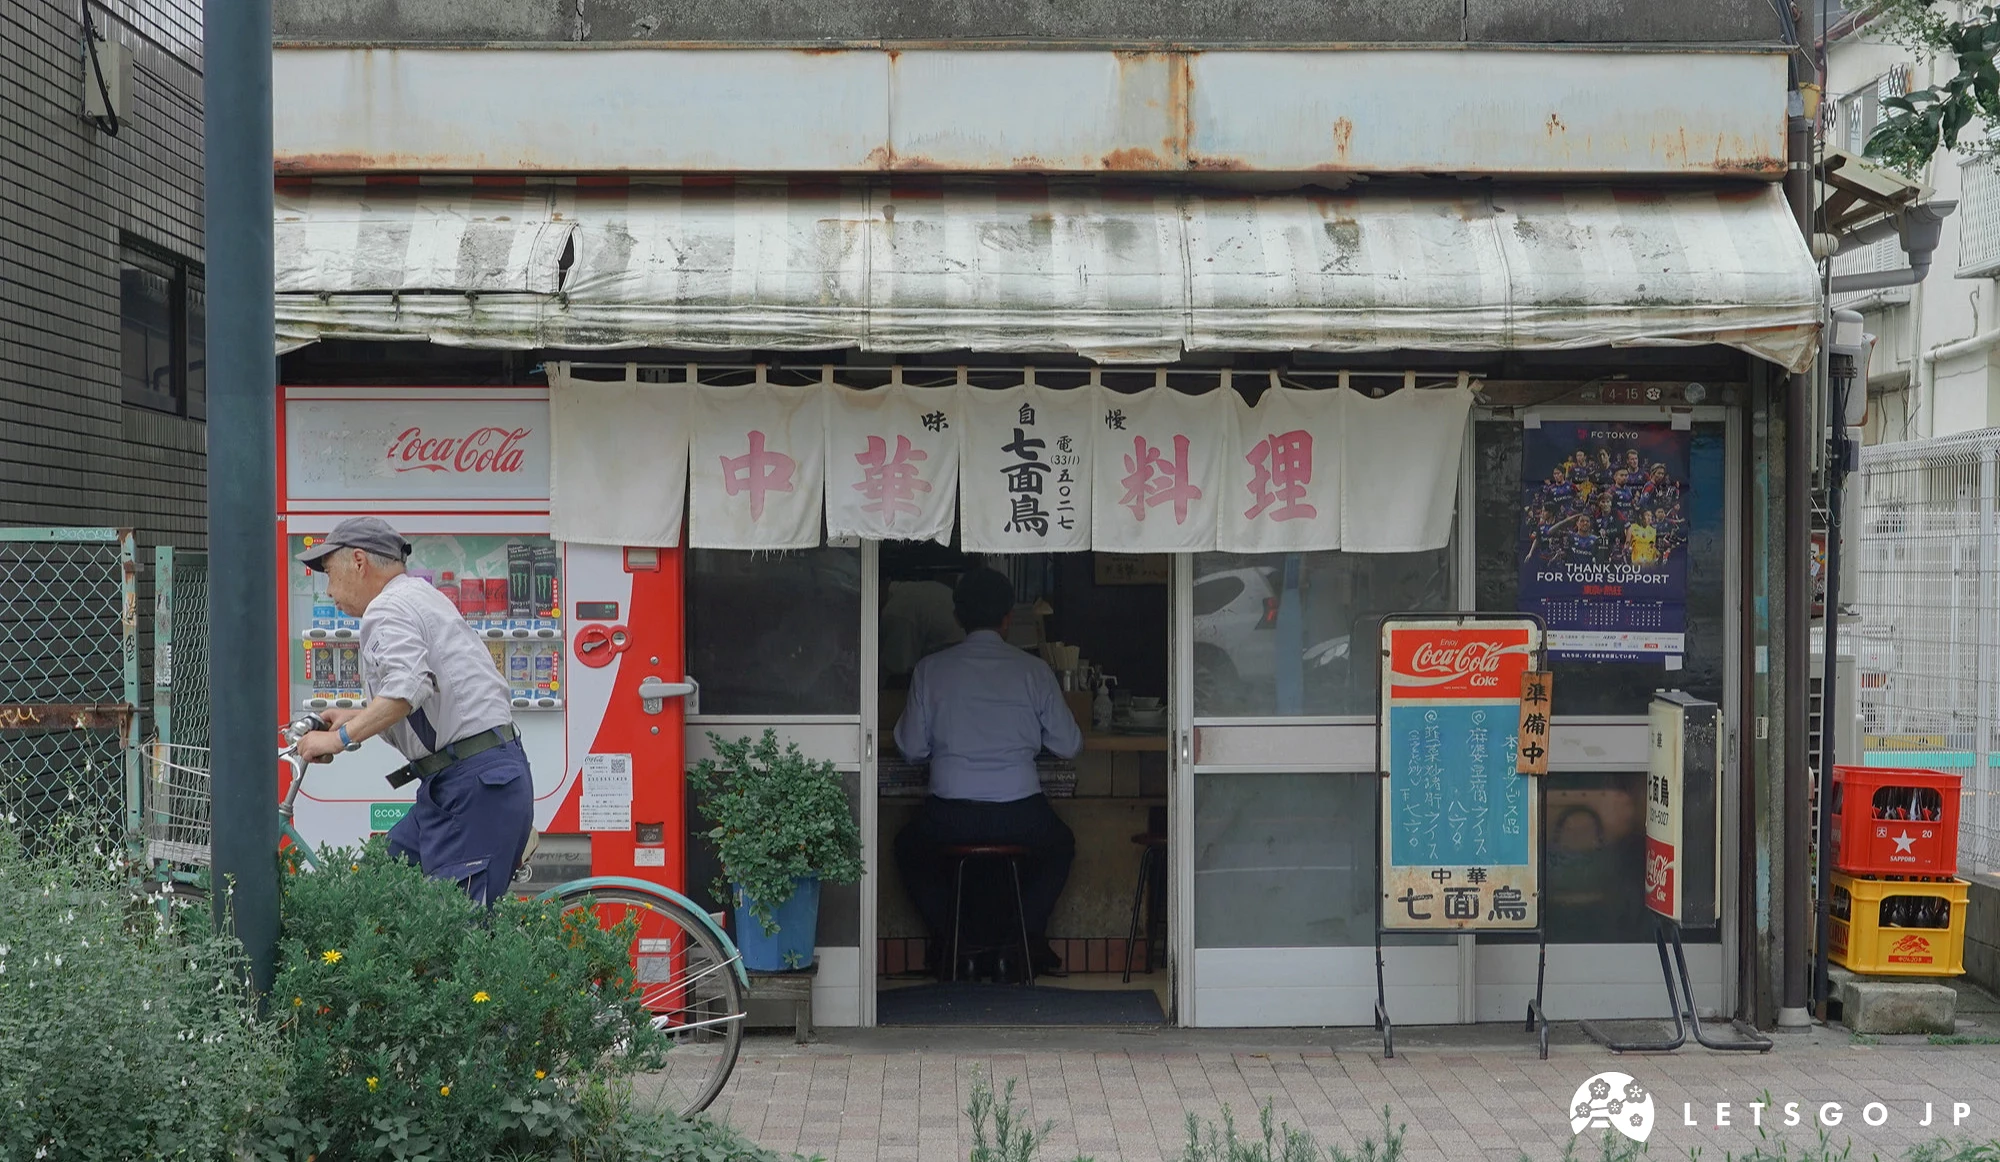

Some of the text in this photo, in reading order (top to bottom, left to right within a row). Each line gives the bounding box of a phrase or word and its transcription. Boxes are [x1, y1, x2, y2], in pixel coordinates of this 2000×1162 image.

[1608, 388, 1639, 400] 4-15
[1590, 430, 1639, 440] FC TOKYO
[1001, 428, 1051, 537] 七面鳥
[1565, 563, 1641, 575] THANK YOU
[1537, 572, 1670, 584] FOR YOUR SUPPORT
[1440, 638, 1460, 649] Enjoy
[1412, 641, 1504, 673] Coca-Cola
[1470, 673, 1499, 687] Coke
[1521, 682, 1548, 765] 準備中
[1921, 829, 1933, 838] 20
[1889, 855, 1916, 863] SAPPORO
[1431, 867, 1488, 885] 中華
[1397, 886, 1528, 922] 七面鳥
